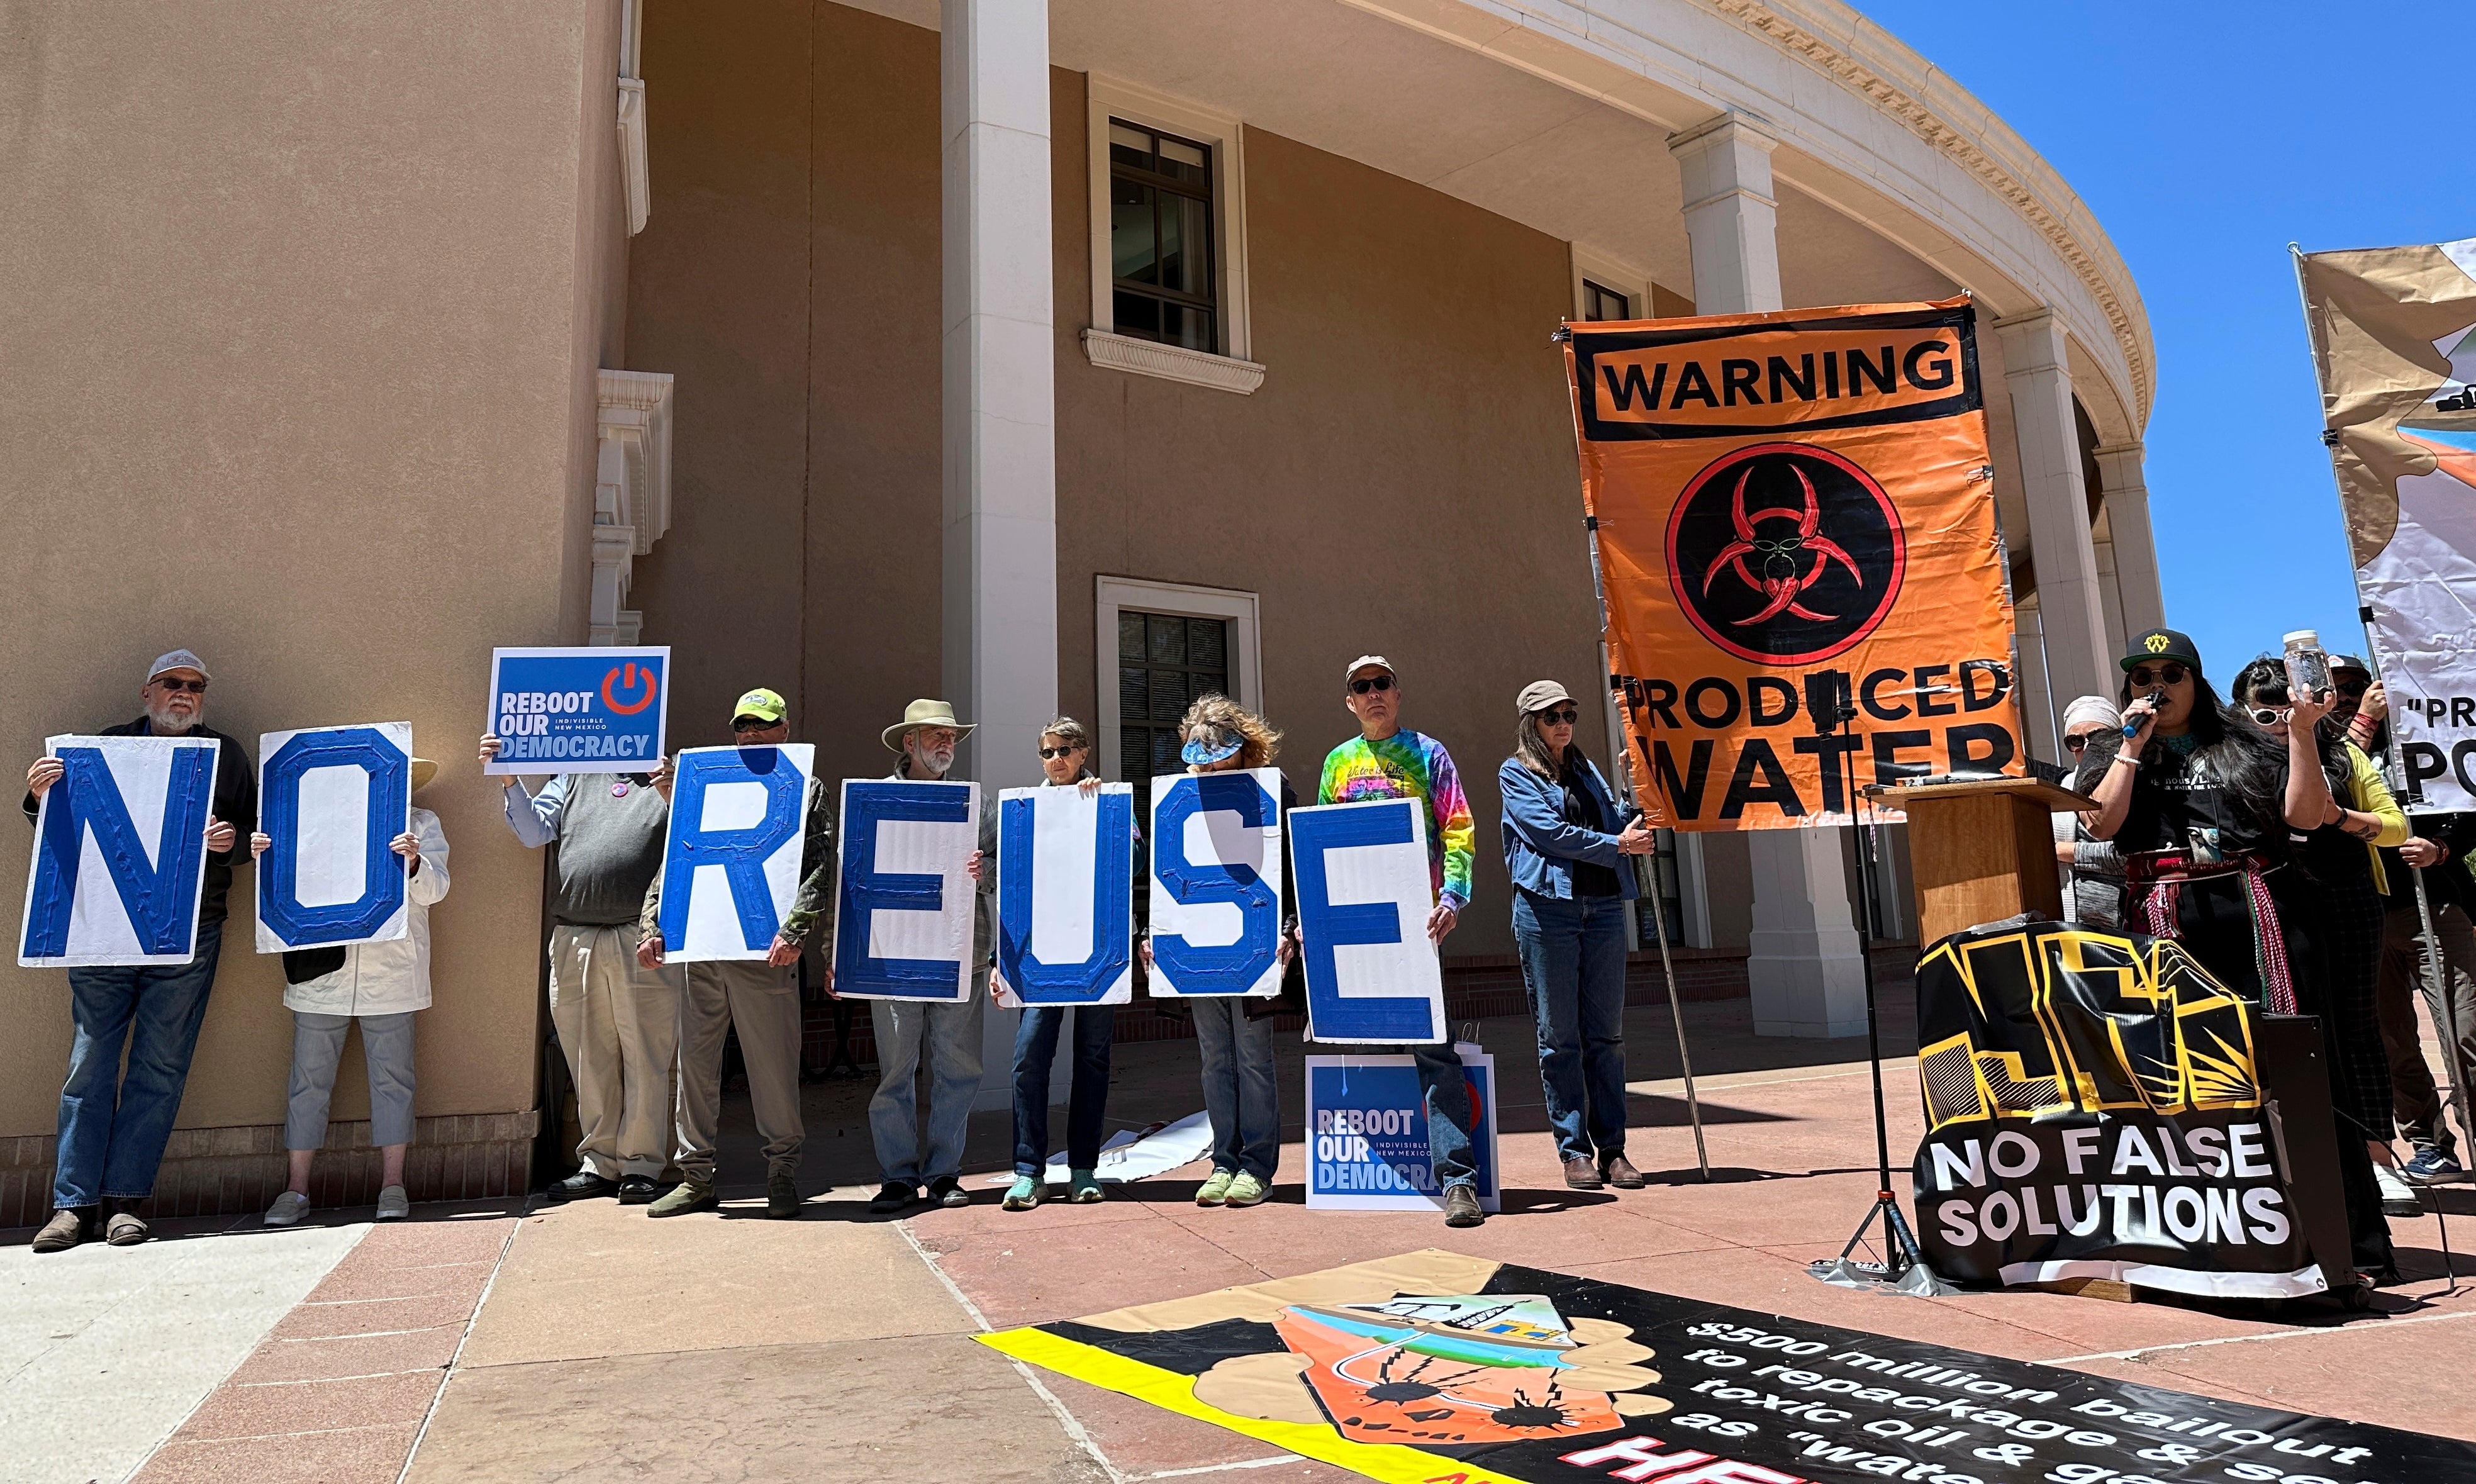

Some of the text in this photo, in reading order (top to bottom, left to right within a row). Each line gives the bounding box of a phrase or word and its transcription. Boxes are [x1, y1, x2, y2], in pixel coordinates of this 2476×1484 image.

[1602, 340, 1955, 411] WARNING
[499, 714, 549, 736] OUR
[501, 691, 594, 714] REBOOT
[1623, 659, 2009, 729] PRODUCED
[498, 734, 650, 759] DEMOCRACY
[1635, 723, 2014, 820] WATER
[1317, 1109, 1414, 1135] REBOOT
[1317, 1135, 1370, 1163] OUR
[1929, 1122, 2272, 1191] NO FALSE
[1938, 1184, 2290, 1247] SOLUTIONS
[1670, 1413, 1759, 1437] as
[1683, 1349, 1748, 1367] to
[1751, 1364, 2117, 1446] repackage
[2136, 1443, 2201, 1466] &
[1687, 1322, 2373, 1465] $500 million bailout
[1690, 1378, 1853, 1422] toxic
[1863, 1419, 1971, 1447] oil
[1973, 1443, 2035, 1466] &
